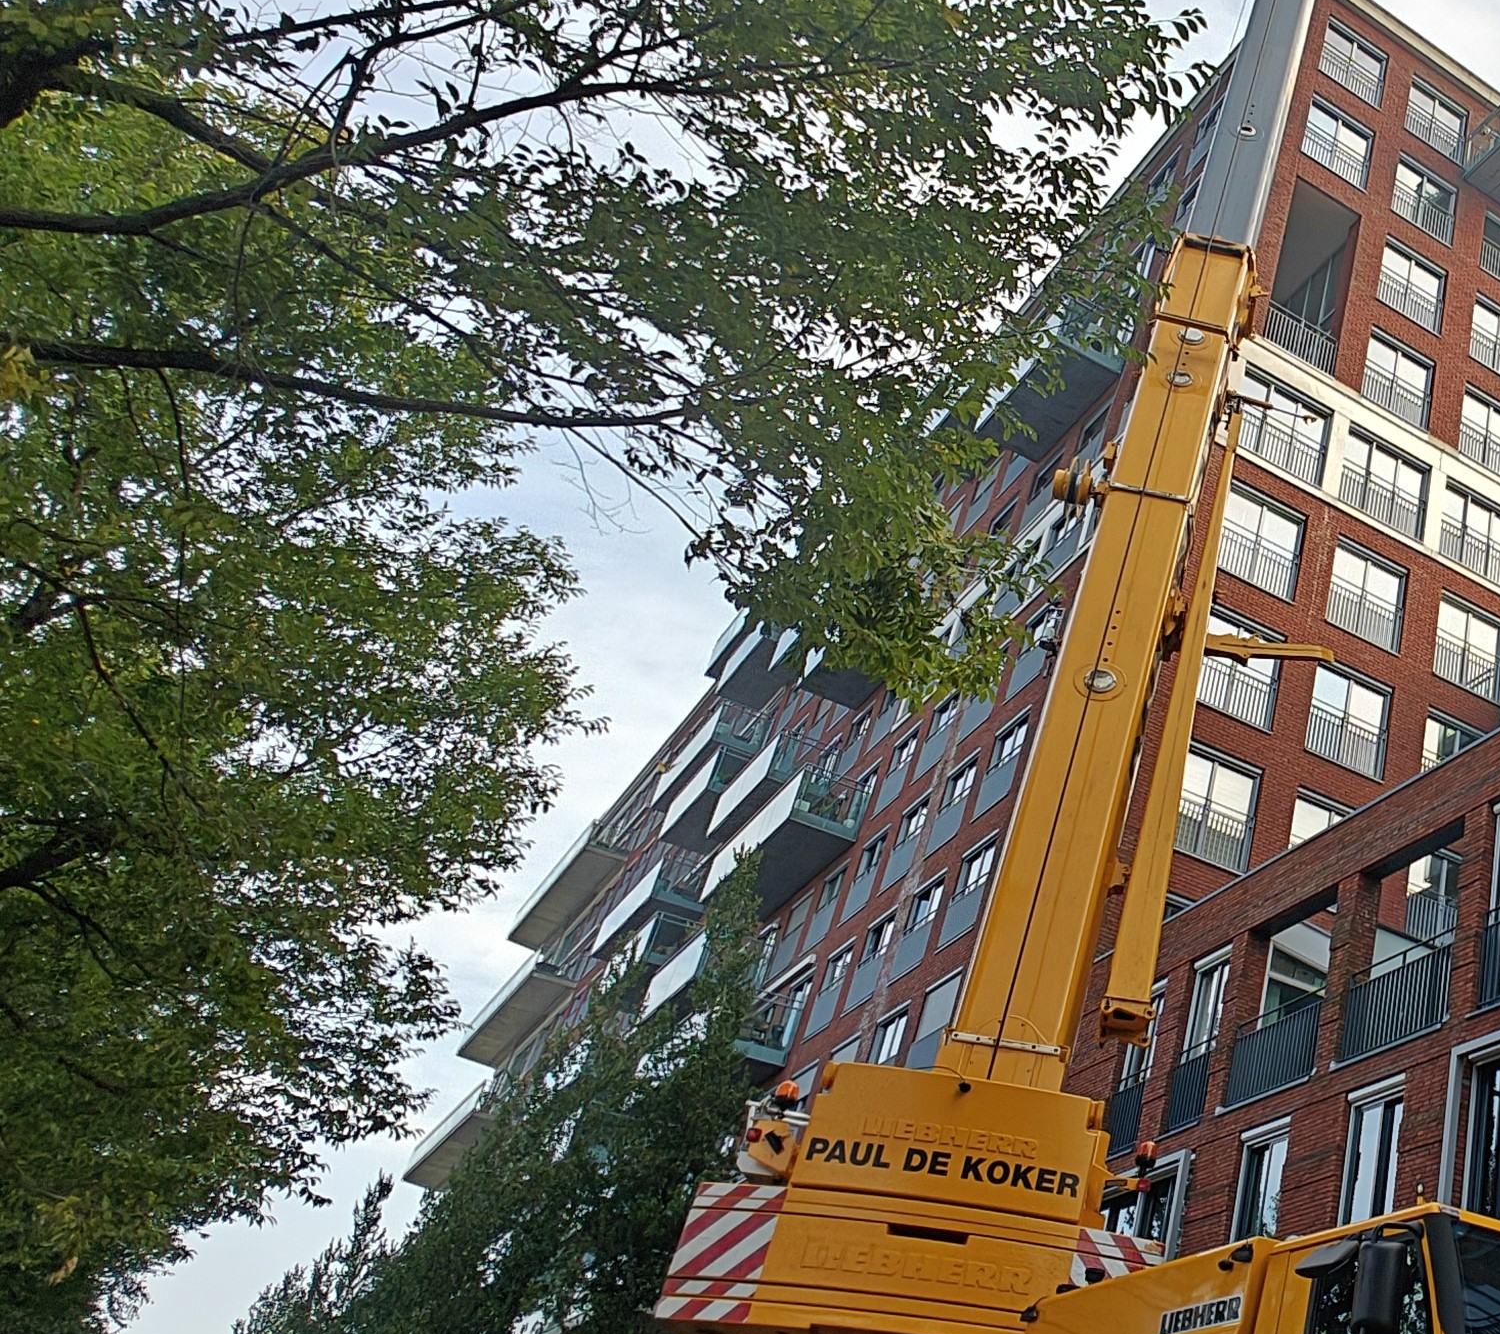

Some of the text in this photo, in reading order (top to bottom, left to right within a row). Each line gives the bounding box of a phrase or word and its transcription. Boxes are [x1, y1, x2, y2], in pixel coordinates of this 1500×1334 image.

[805, 1137, 1082, 1198] PAUL DE KOKER
[861, 1116, 1039, 1160] LIEBHERR
[800, 1237, 1032, 1296] LIEBHERR
